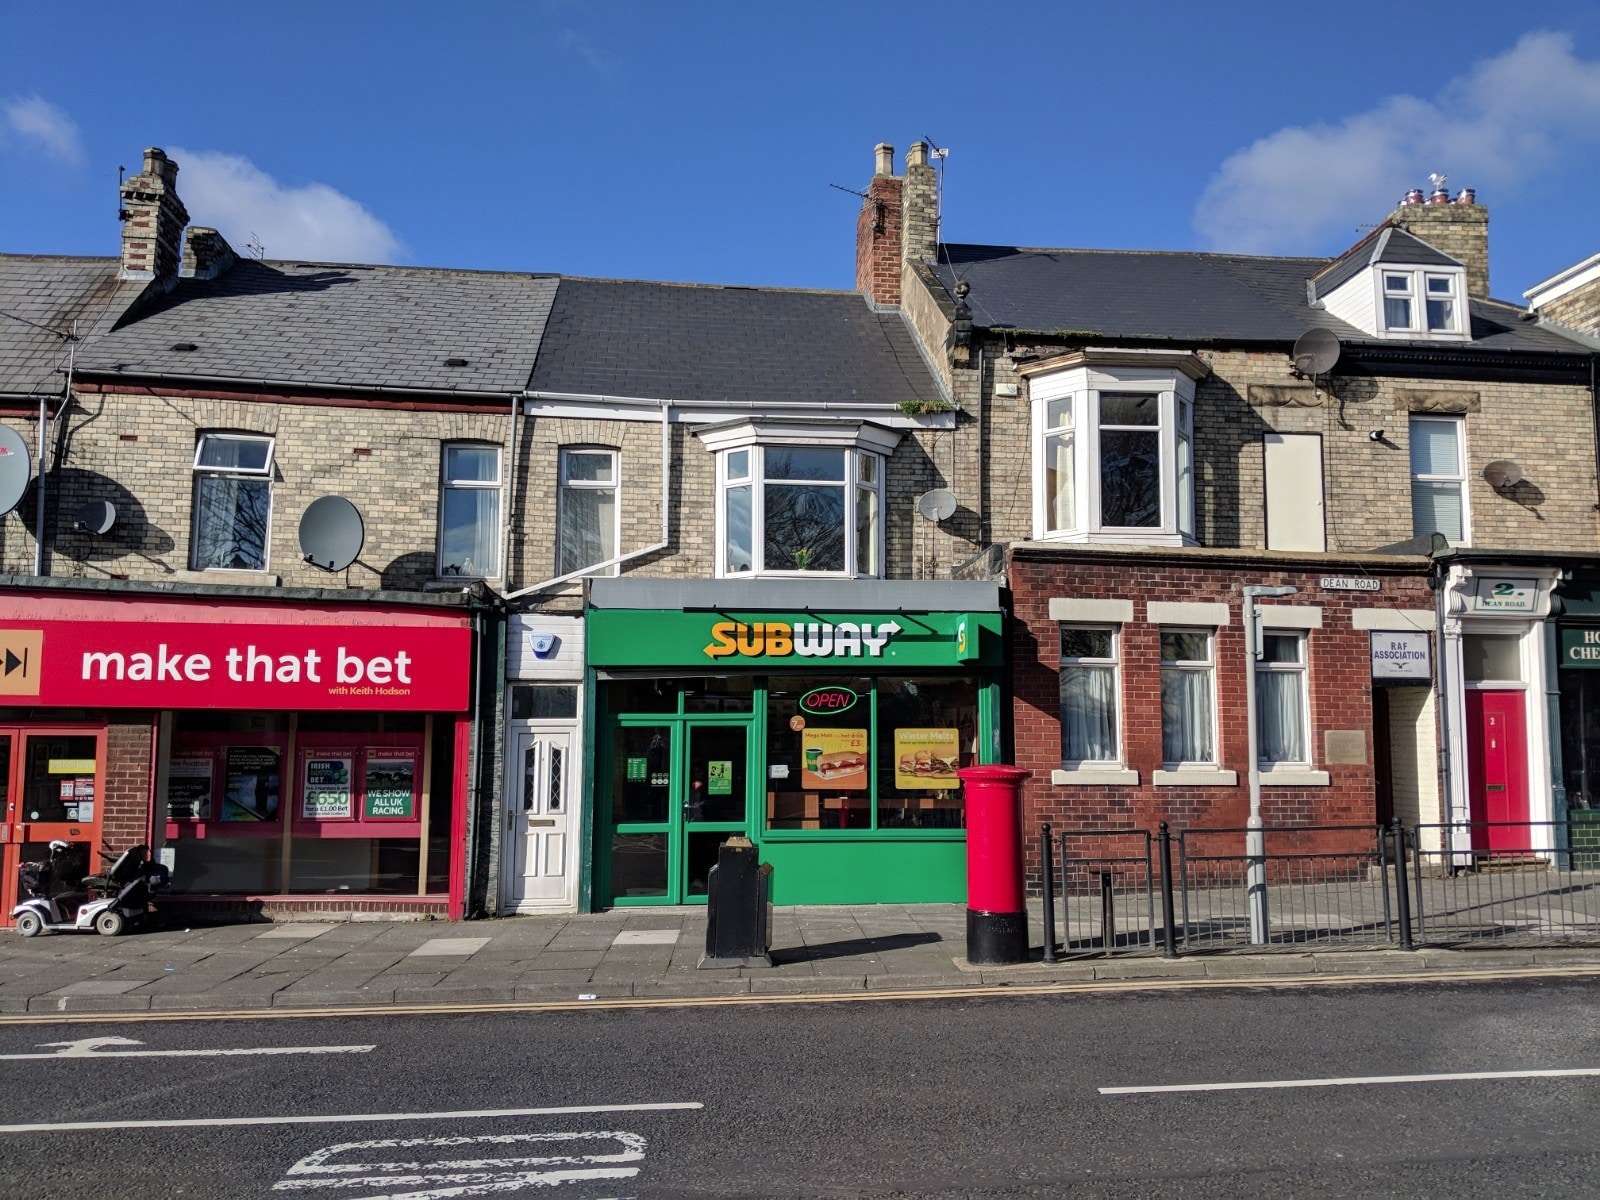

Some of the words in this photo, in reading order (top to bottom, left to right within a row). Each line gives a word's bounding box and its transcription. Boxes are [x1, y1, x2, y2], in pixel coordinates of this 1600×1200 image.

[1323, 578, 1348, 588] DEAN
[1354, 580, 1378, 590] ROAD
[702, 620, 905, 660] SUBWAY
[1390, 642, 1408, 651] RAF
[1374, 650, 1426, 660] ASSOCIATION
[82, 644, 211, 681] make
[226, 645, 322, 683] that
[336, 647, 412, 685] bet
[328, 686, 348, 695] with
[350, 686, 374, 696] Keith
[374, 686, 411, 696] Hodson
[806, 693, 850, 708] OPEN
[1490, 717, 1496, 726] 2
[899, 732, 928, 740] Winter
[930, 732, 954, 740] Melts
[310, 762, 330, 770] IRISH
[310, 776, 325, 784] BET
[305, 791, 348, 805] £650
[367, 790, 382, 798] WE
[383, 789, 411, 798] SHOW
[372, 807, 404, 815] RACING
